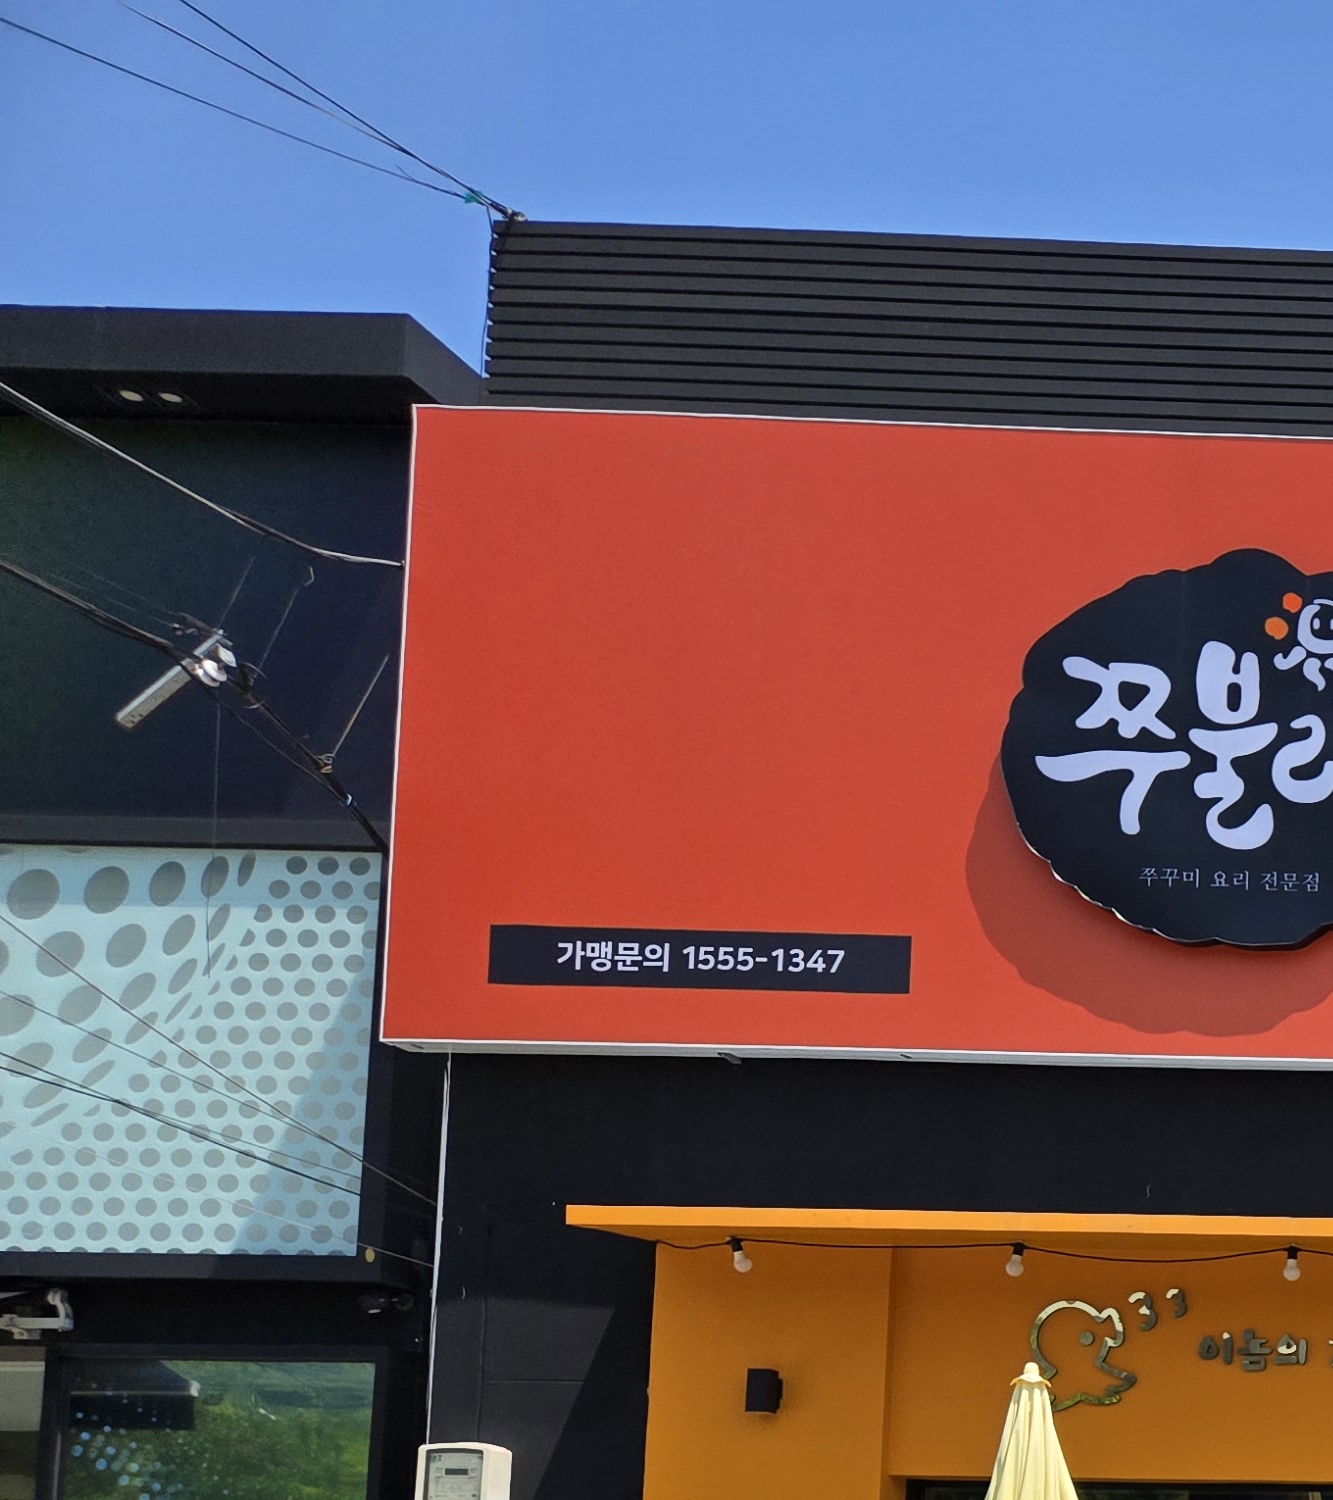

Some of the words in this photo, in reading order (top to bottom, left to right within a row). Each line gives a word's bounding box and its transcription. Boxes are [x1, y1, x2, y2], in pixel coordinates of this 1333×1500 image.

[1138, 867, 1200, 889] 쭈꾸미
[1210, 869, 1250, 891] 요리
[1259, 870, 1321, 893] 전문점
[557, 940, 671, 972] 가맹문의
[682, 945, 846, 974] 1555-1347
